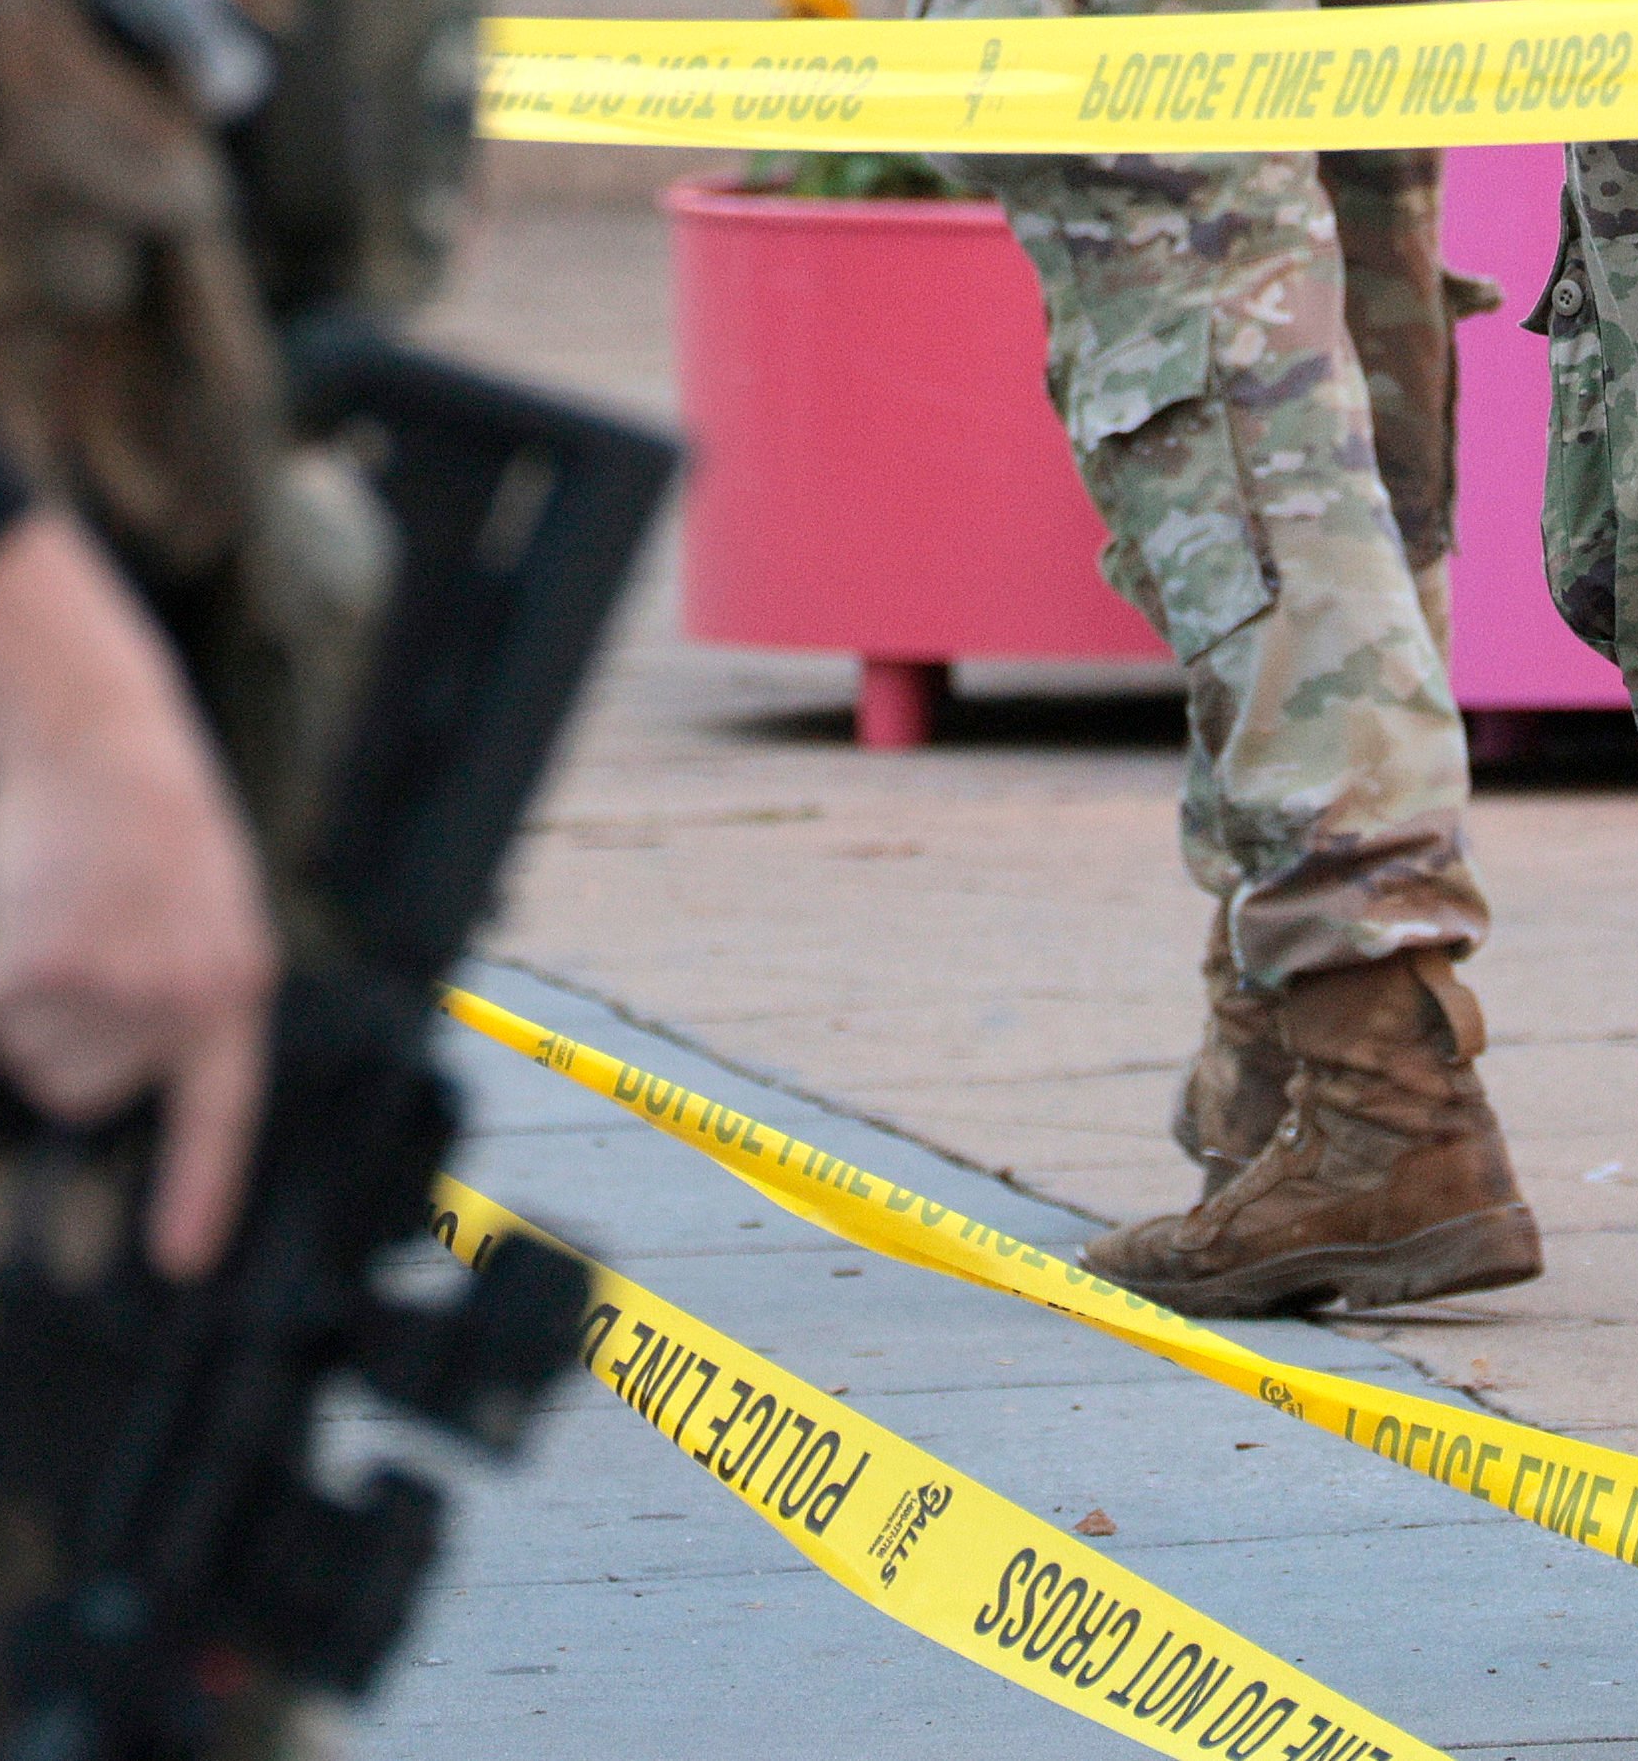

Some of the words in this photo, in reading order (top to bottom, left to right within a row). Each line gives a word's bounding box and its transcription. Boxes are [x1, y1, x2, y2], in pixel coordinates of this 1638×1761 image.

[610, 1320, 721, 1446] LINE
[693, 1378, 872, 1538] POLICE
[880, 1480, 954, 1590] GALLS
[973, 1547, 1142, 1689] CROSS
[1104, 1630, 1236, 1736] NOT
[1197, 1679, 1300, 1761] DO
